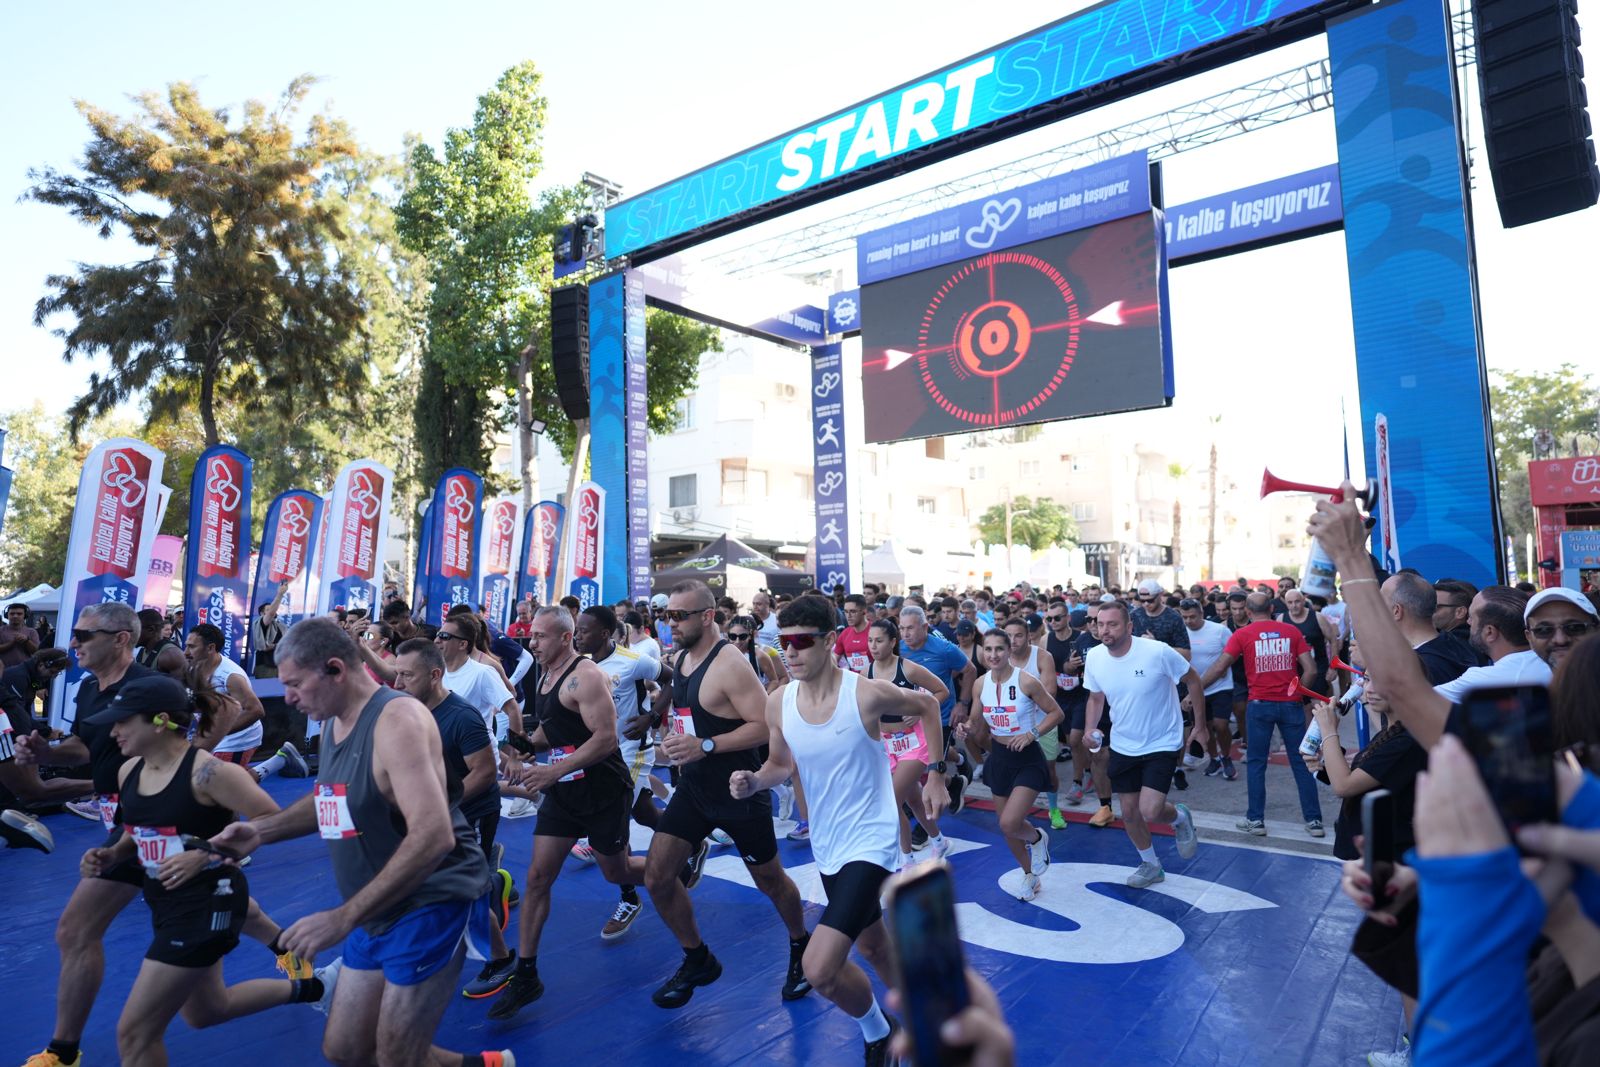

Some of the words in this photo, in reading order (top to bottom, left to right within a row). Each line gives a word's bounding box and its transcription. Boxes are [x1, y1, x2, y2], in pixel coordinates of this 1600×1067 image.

[622, 142, 783, 249] START
[775, 55, 996, 192] START
[1026, 199, 1058, 220] kalpten
[1058, 193, 1083, 211] kalbe
[1083, 179, 1129, 205] koşuyoruz
[1176, 205, 1225, 243] kalbe
[1229, 181, 1332, 230] koşuyoruz
[866, 243, 893, 265] running
[892, 240, 911, 258] from
[910, 233, 931, 253] heart
[939, 225, 960, 243] heart
[99, 492, 119, 522] kalbe
[204, 499, 220, 529] kalbe
[345, 507, 361, 534] kalbe
[92, 519, 112, 563] kalpten
[111, 514, 136, 569] koşuyoruz
[202, 525, 217, 565] kalpten
[216, 518, 235, 570] koşuyoruz
[340, 531, 357, 567] kalpten
[355, 524, 373, 572] koşuyoruz
[1254, 637, 1291, 657] HAKEM
[1254, 652, 1294, 674] REFEREE
[990, 714, 1011, 728] 5005
[892, 735, 910, 752] 5047
[319, 801, 339, 827] 5173
